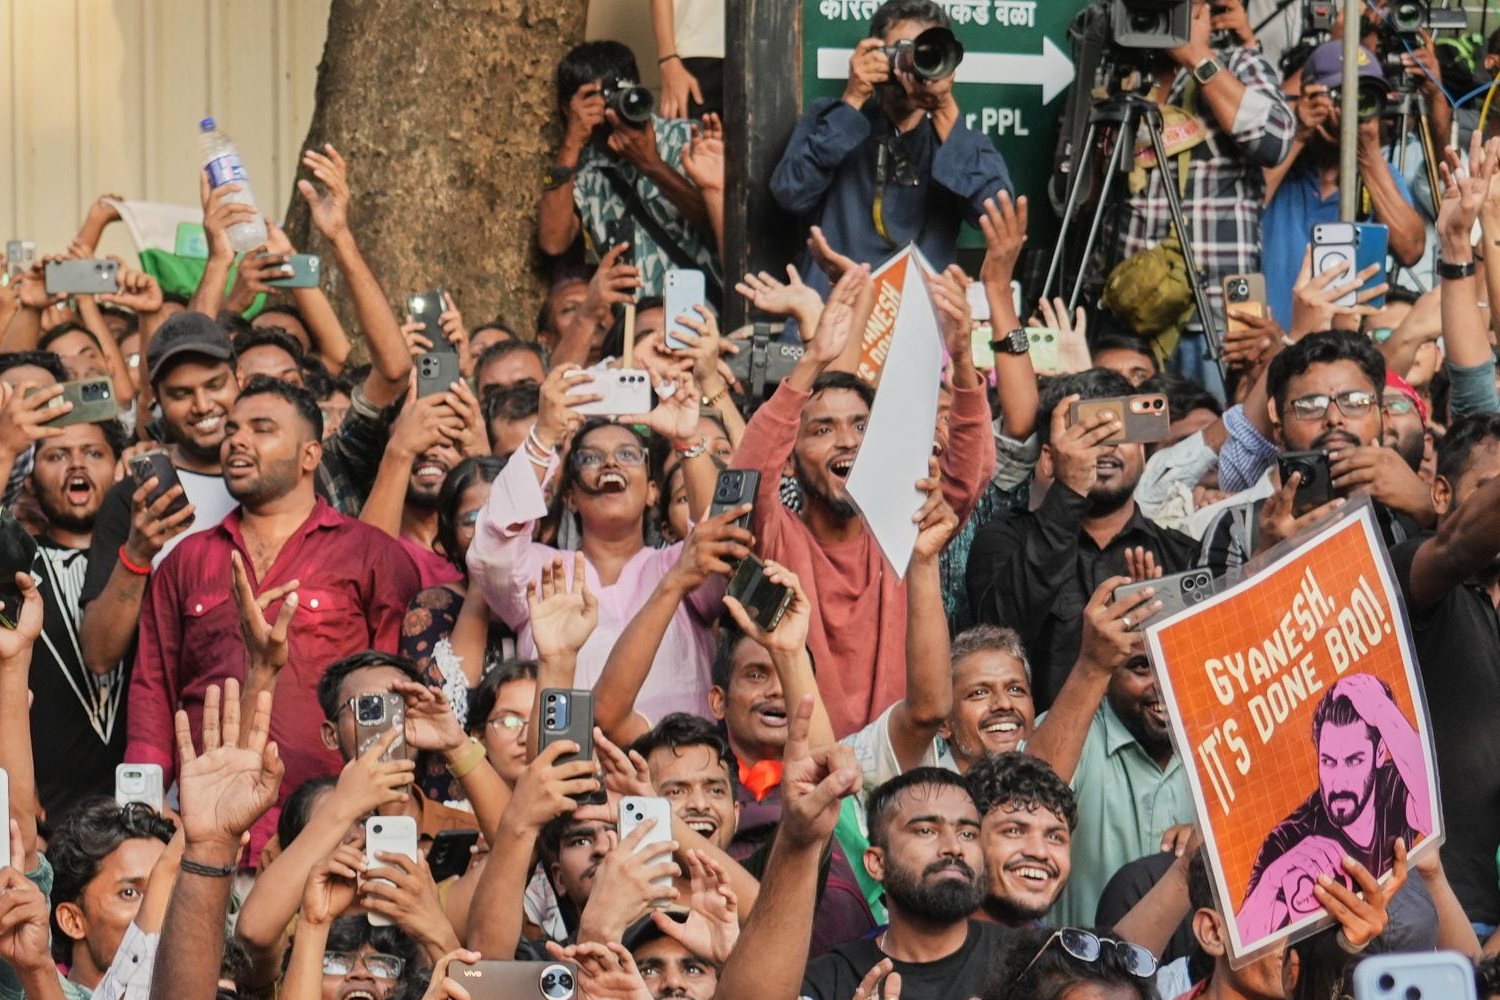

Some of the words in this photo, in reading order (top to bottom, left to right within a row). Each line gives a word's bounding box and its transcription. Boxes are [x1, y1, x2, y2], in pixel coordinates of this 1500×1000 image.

[982, 107, 1029, 136] PPL
[1198, 727, 1251, 816] IT'S
[1248, 652, 1323, 744] DONE
[1324, 574, 1392, 675] BRO!
[1205, 565, 1336, 706] GYANESH,
